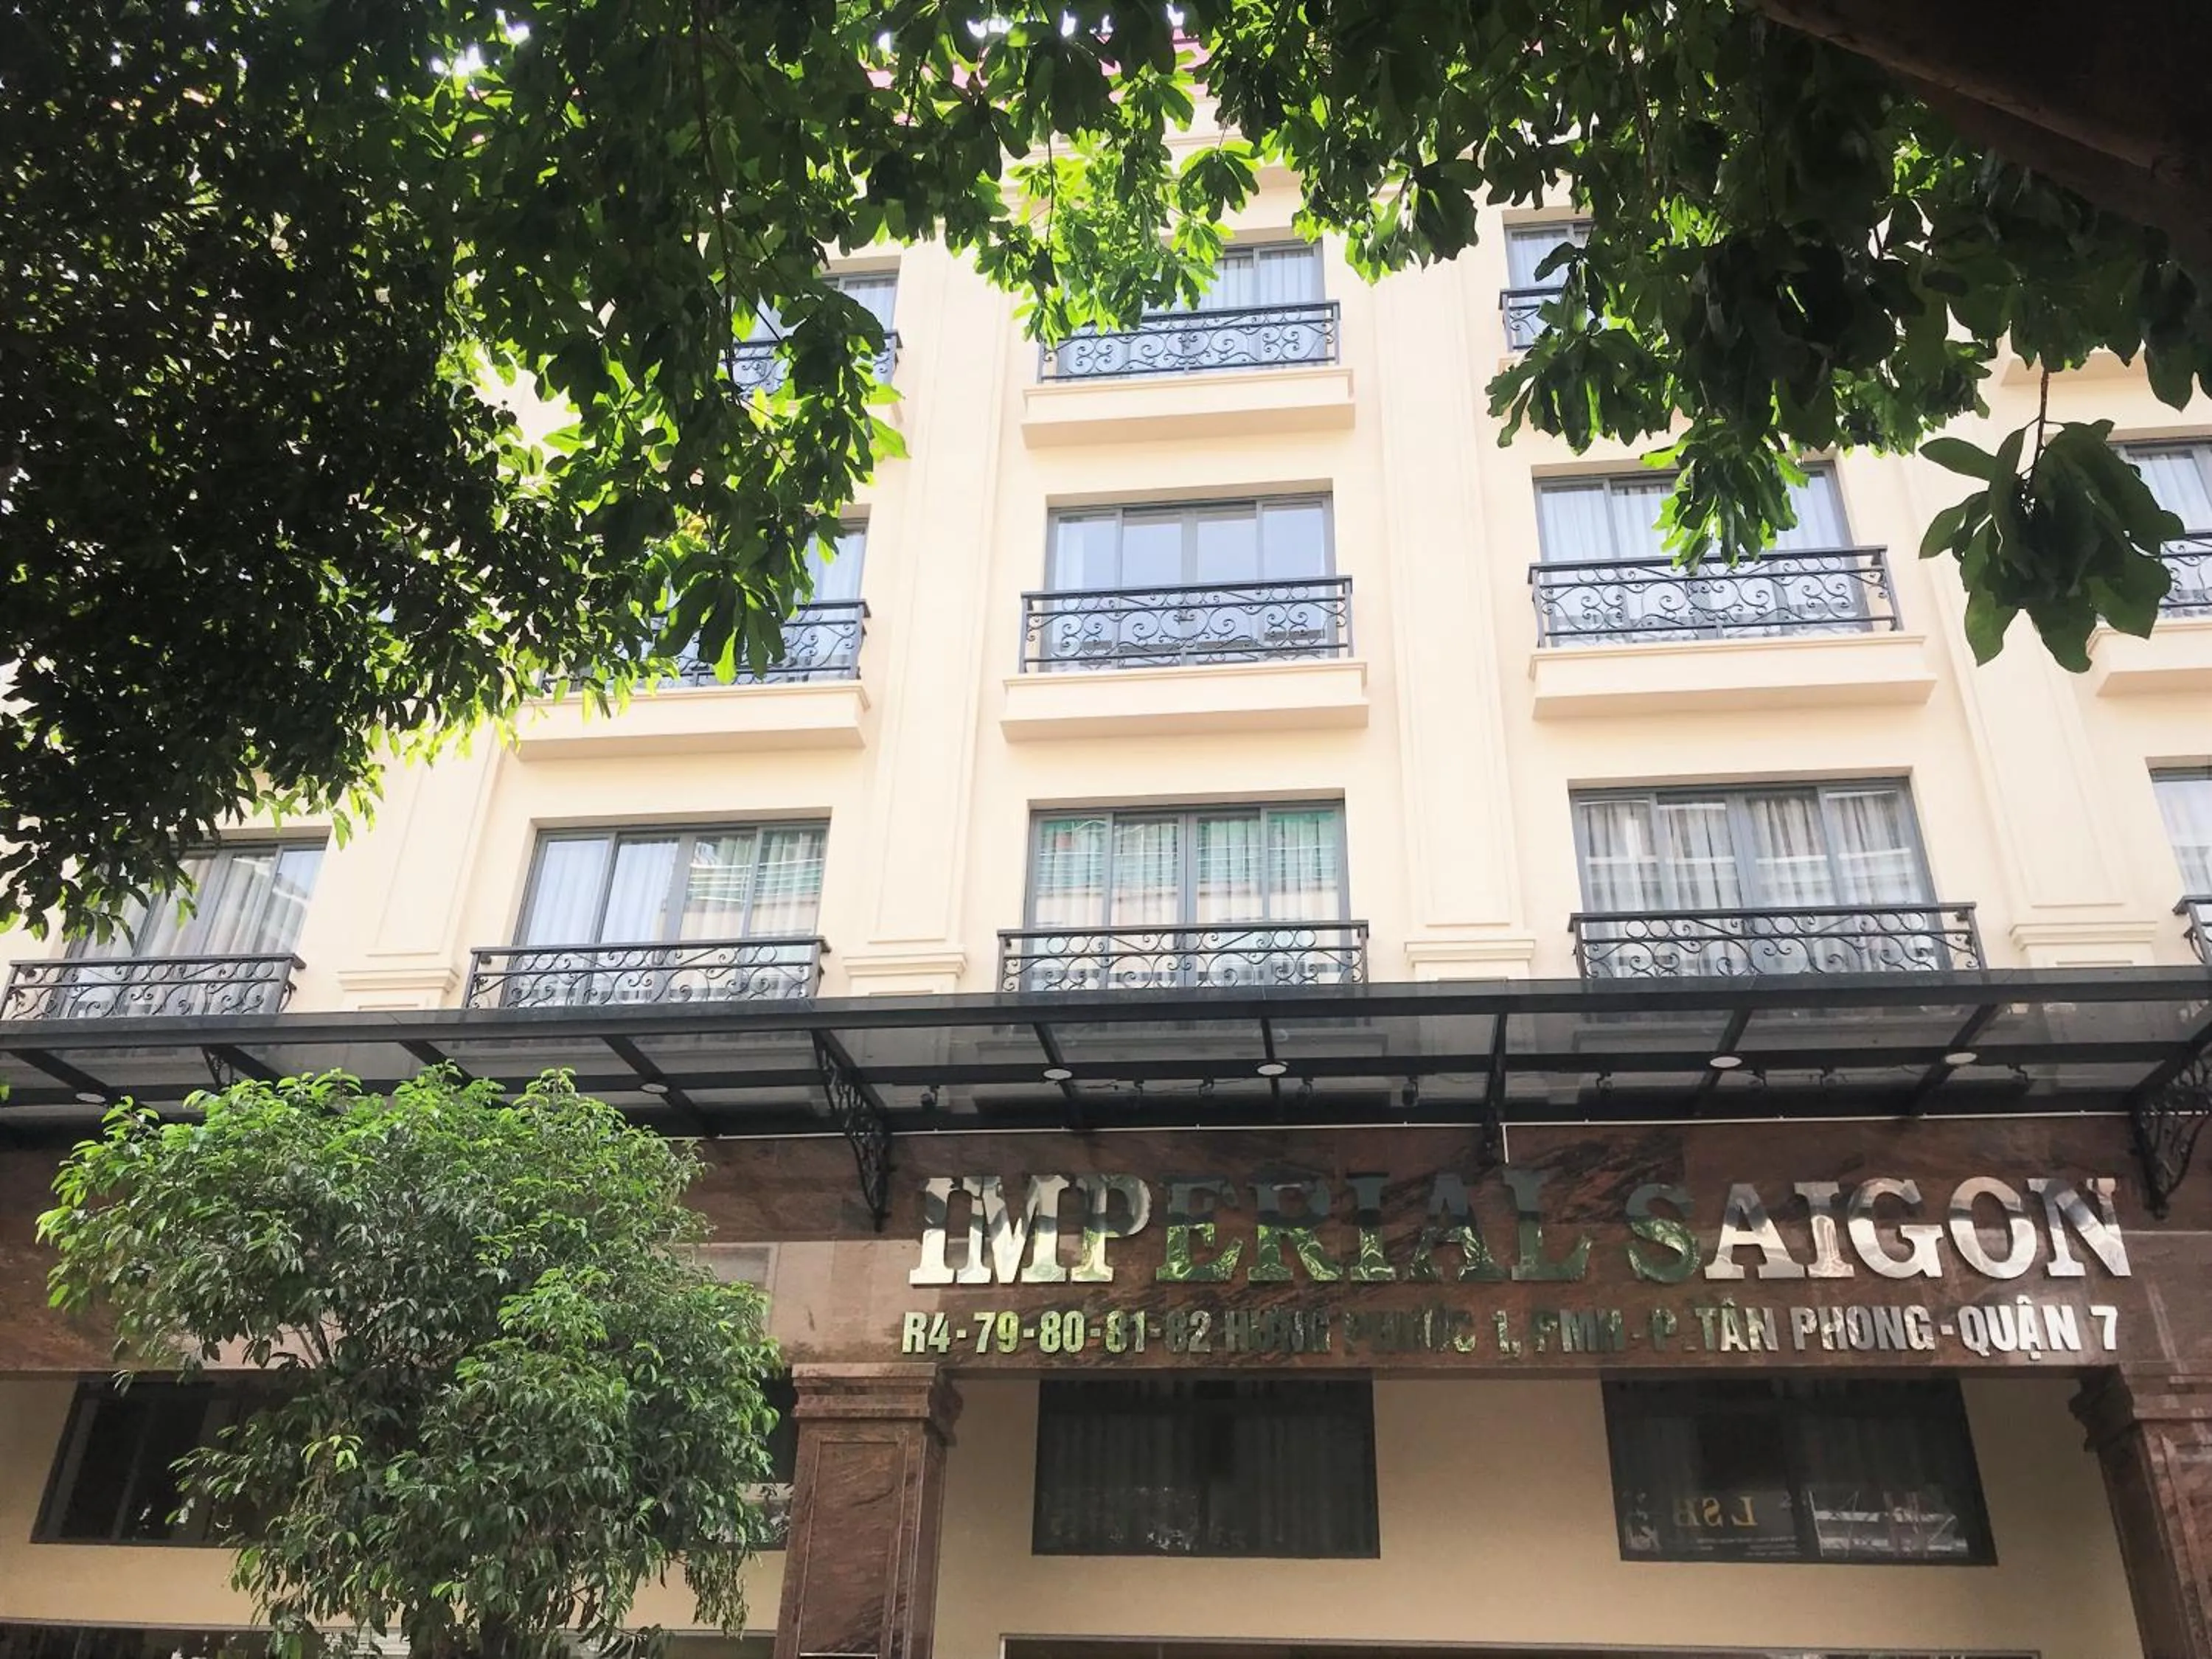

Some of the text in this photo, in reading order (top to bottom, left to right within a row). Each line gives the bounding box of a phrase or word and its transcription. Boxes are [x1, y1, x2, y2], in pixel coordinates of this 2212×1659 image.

[908, 1170, 2132, 1286] IMPERIAL SAIGON
[2090, 1306, 2119, 1352] 7
